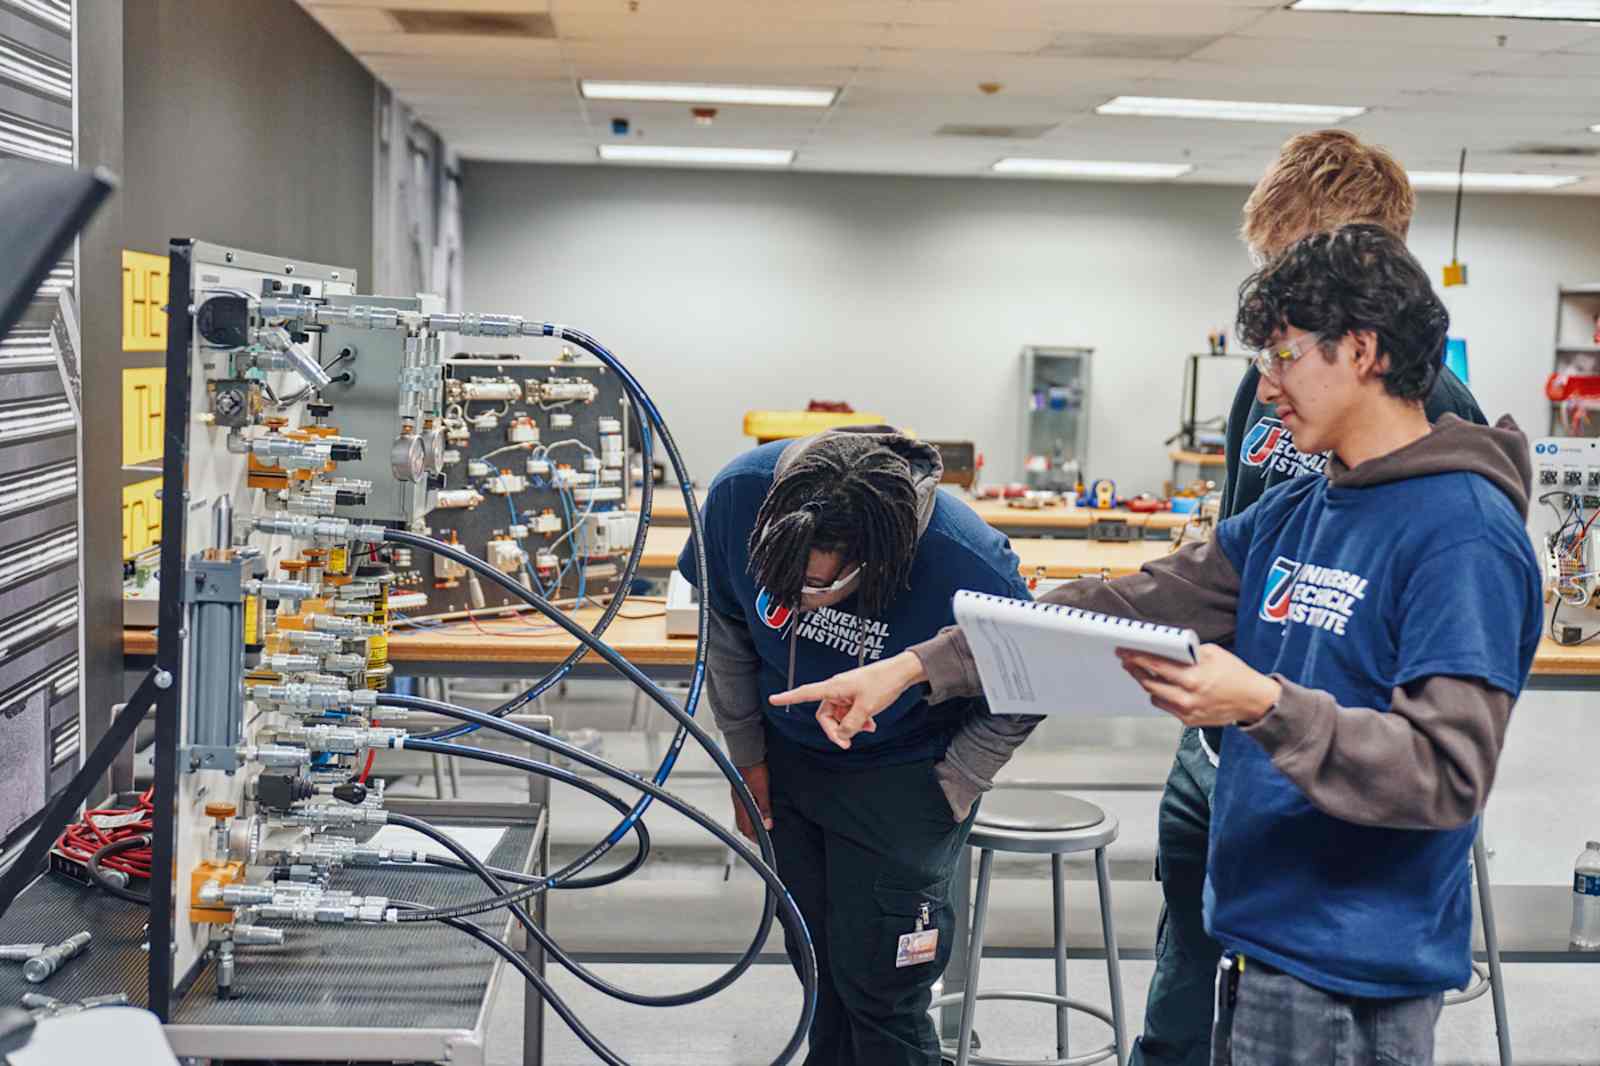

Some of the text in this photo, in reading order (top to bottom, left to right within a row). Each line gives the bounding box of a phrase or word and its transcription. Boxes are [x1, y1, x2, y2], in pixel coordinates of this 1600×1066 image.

[803, 611, 885, 649] TECHNICAL
[816, 606, 890, 637] NIVERSAL
[795, 622, 882, 660] INSTITUTE
